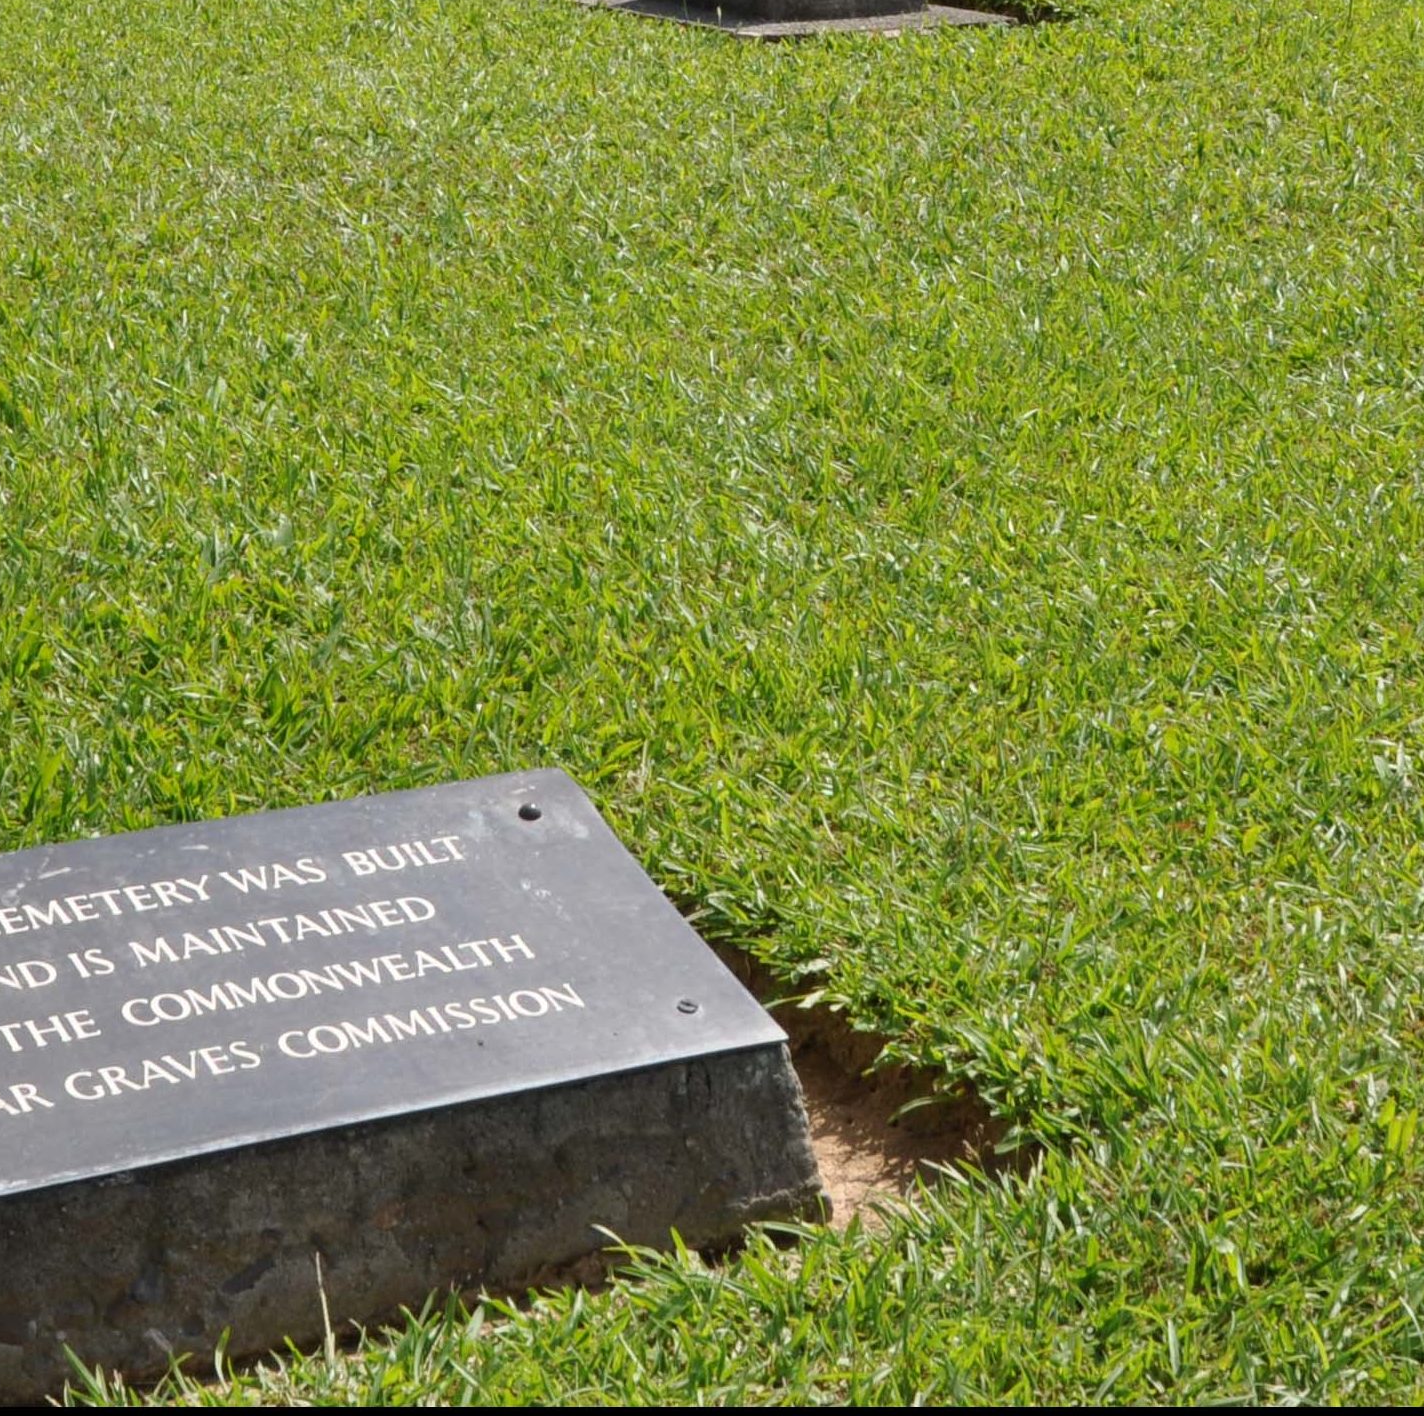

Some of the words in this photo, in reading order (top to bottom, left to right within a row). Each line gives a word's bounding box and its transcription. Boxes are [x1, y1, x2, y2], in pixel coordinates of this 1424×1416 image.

[219, 857, 328, 894] WAS
[342, 835, 465, 876] BUILT
[67, 948, 116, 979] IS
[128, 896, 436, 969] MAINTAINED
[121, 934, 537, 1027] COMMONWEALTH
[64, 1040, 262, 1101] GRAVES
[277, 983, 586, 1059] COMMISSION
